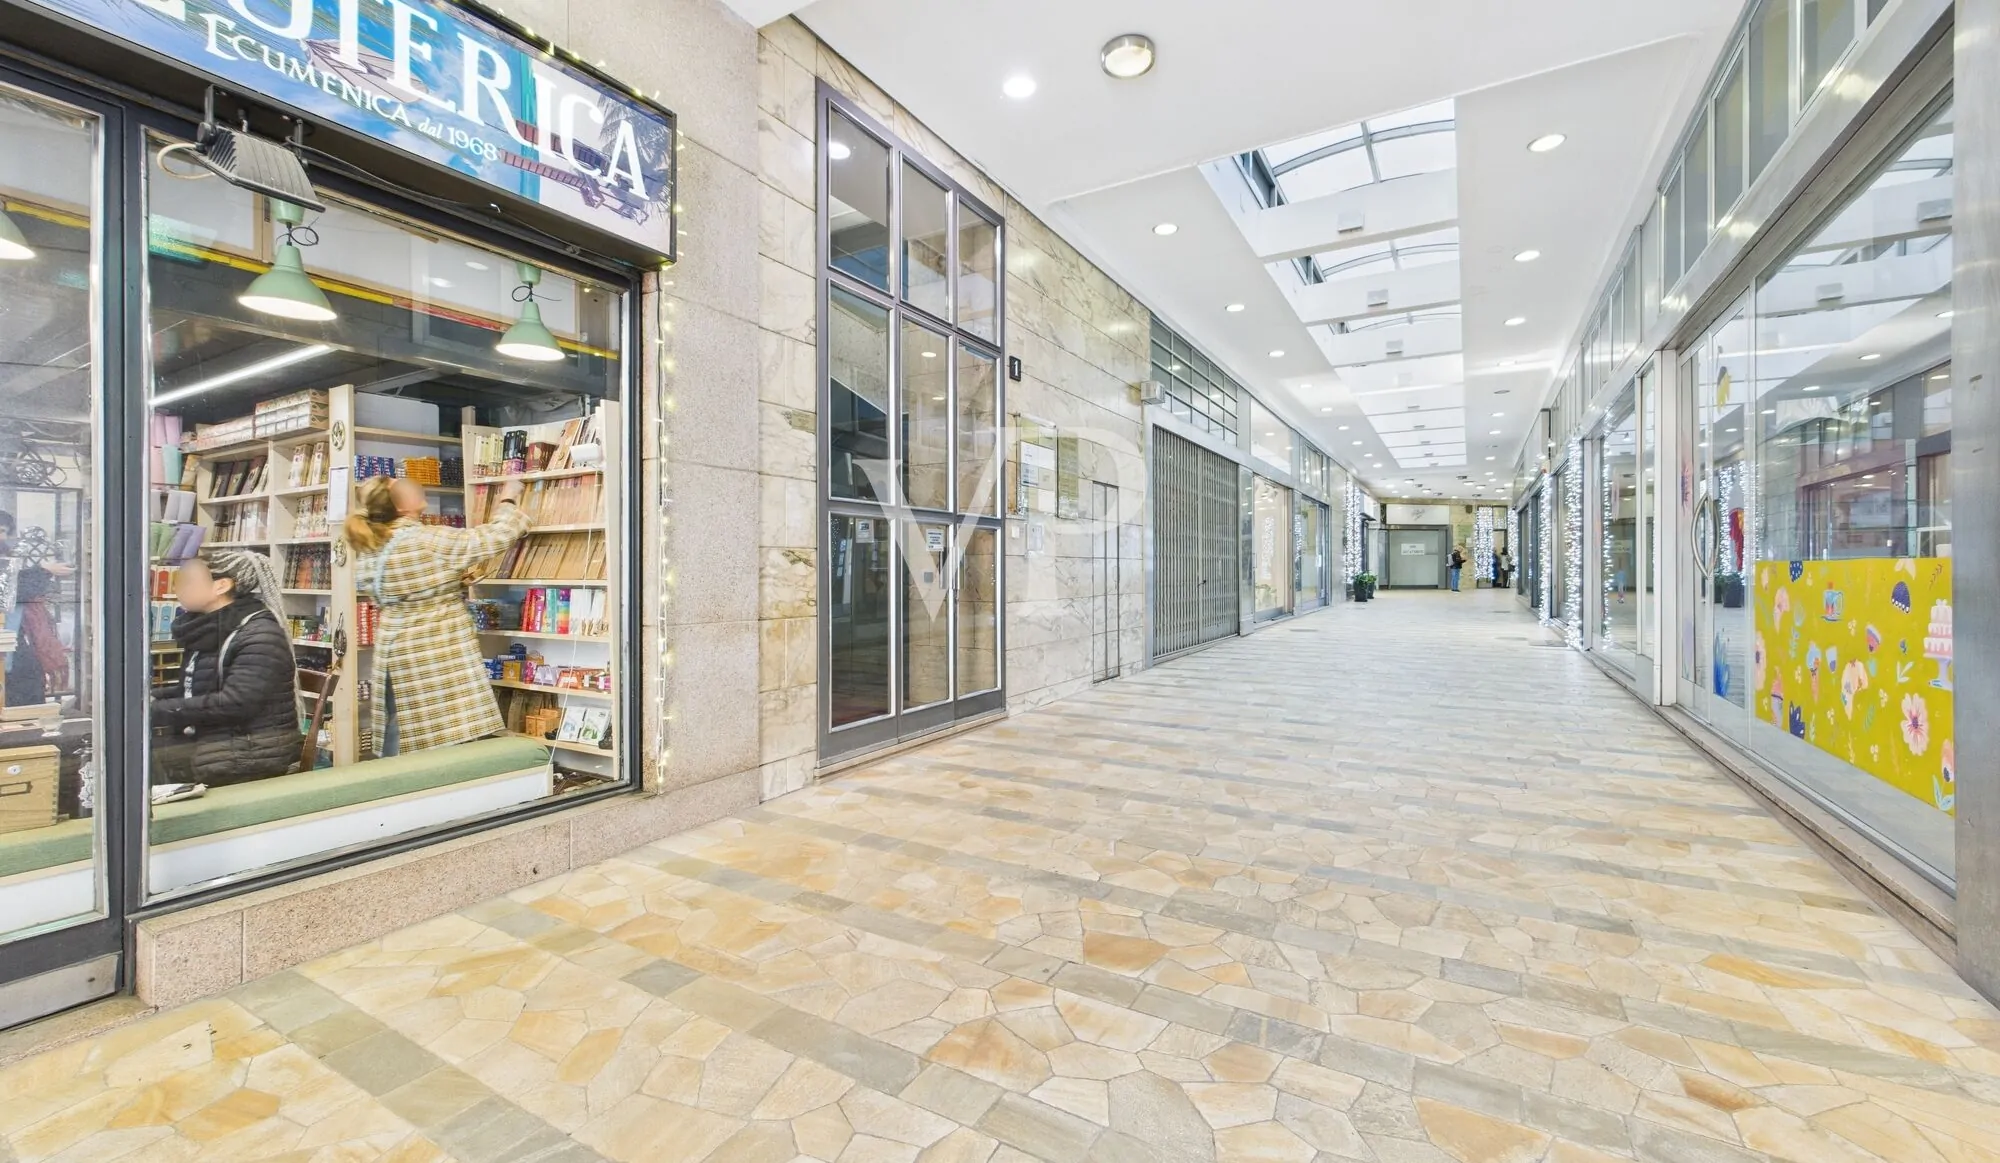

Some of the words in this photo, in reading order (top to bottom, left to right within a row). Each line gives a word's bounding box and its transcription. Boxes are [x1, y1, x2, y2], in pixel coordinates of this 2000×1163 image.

[200, 13, 412, 128] ECUMENICA
[418, 117, 444, 139] dal
[447, 126, 498, 161] 1968
